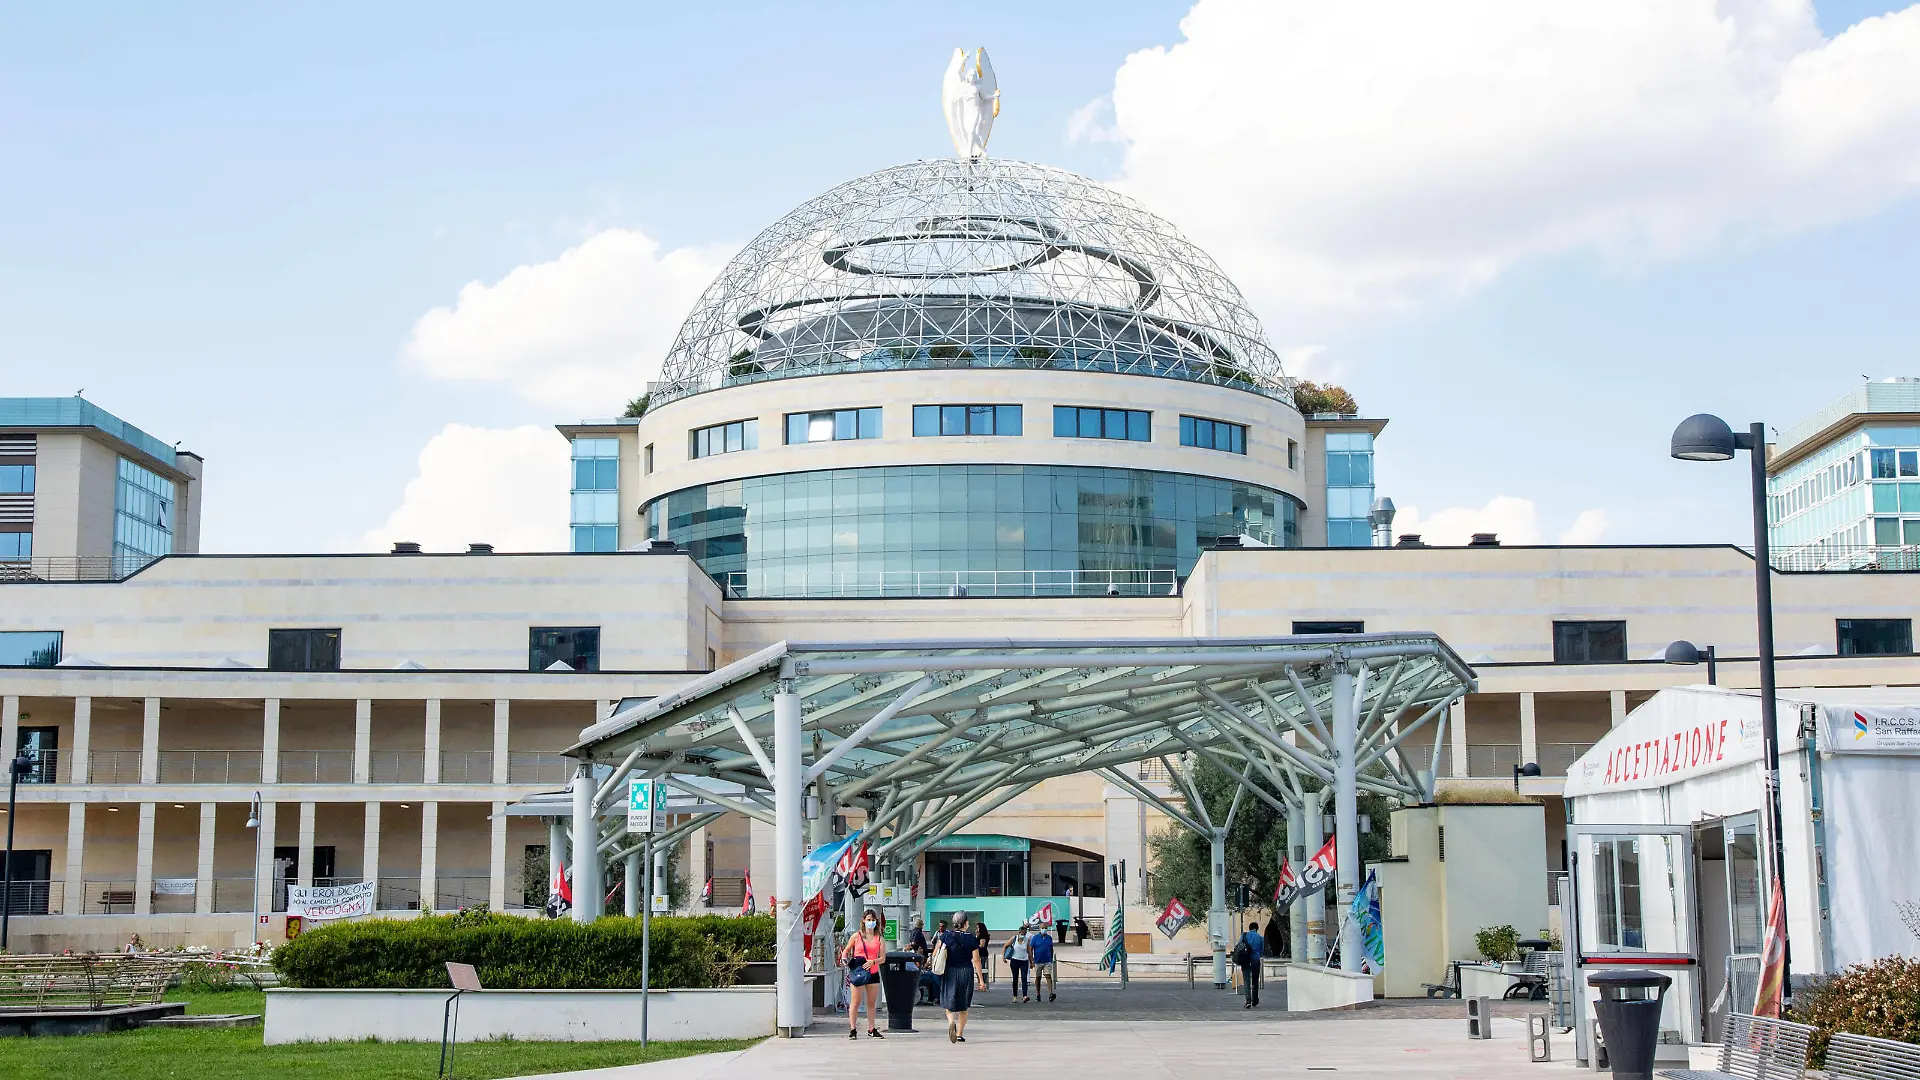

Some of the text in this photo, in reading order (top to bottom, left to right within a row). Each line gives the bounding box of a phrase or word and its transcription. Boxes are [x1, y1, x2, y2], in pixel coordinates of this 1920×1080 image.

[1875, 717, 1917, 726] I.R.C.C.S.
[1875, 727, 1893, 735] San
[1604, 719, 1728, 785] ACCETTAZIONE
[294, 881, 374, 898] GLI EROI DICONO
[341, 891, 372, 904] CONTRATTO
[303, 898, 366, 917] VERGOGNA!
